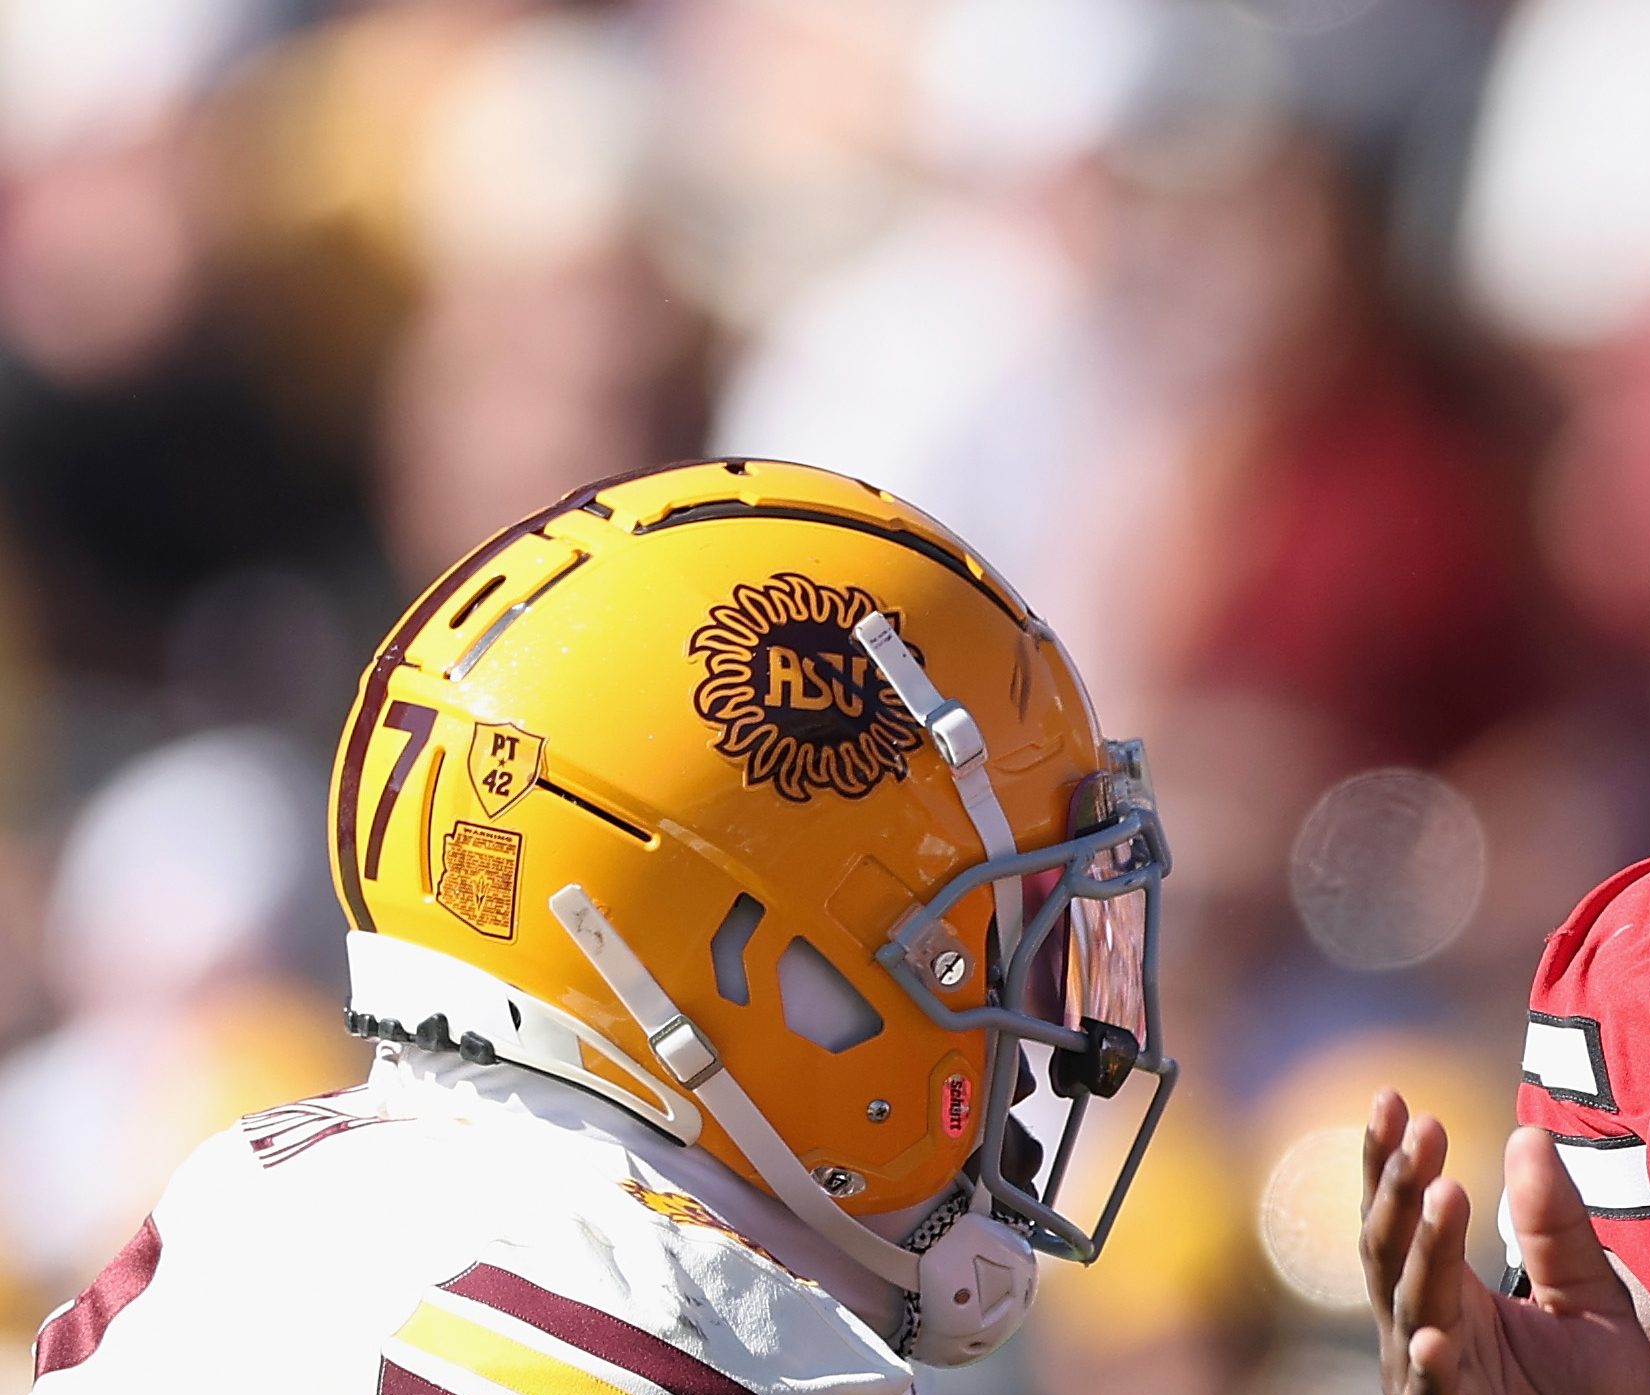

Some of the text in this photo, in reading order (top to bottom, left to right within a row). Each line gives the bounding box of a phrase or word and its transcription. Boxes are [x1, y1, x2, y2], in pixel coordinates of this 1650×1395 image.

[764, 645, 868, 719] ASU
[490, 732, 520, 761] PT
[364, 699, 439, 882] 7
[482, 769, 513, 797] 42
